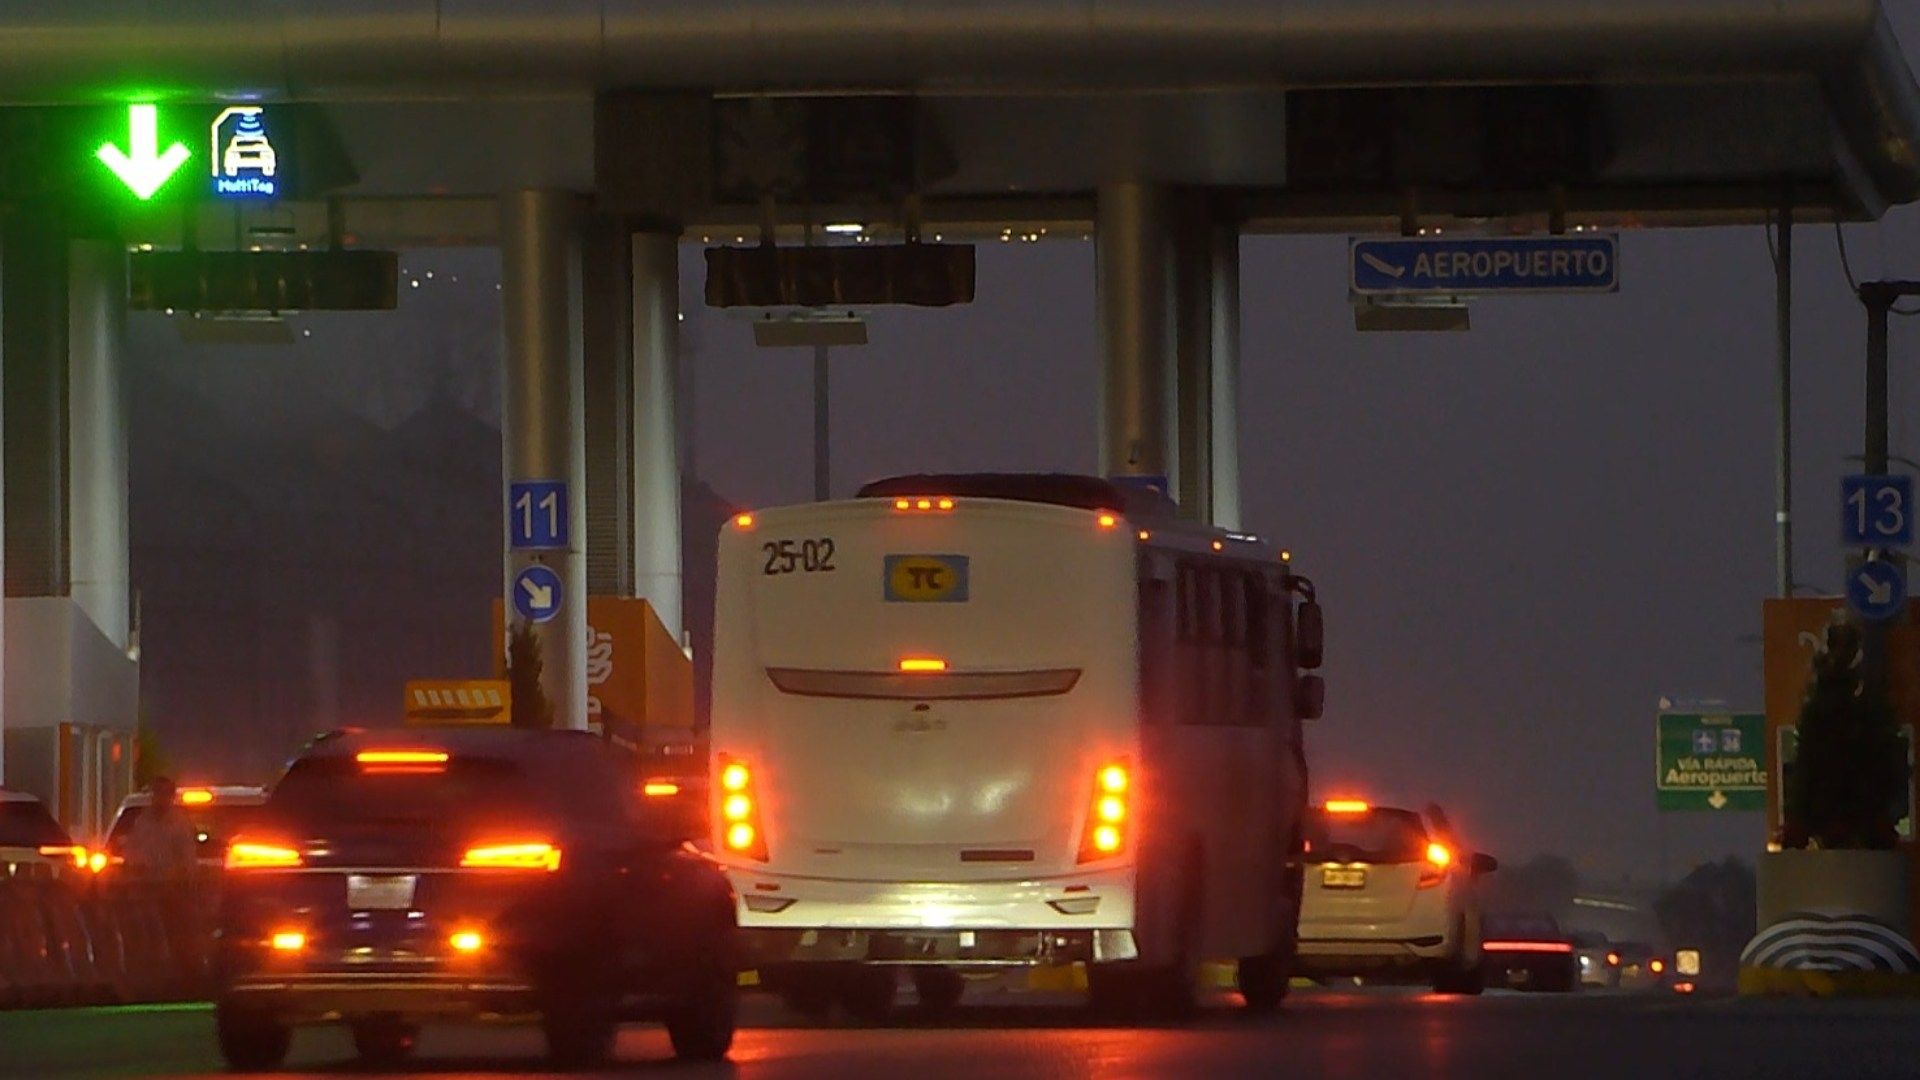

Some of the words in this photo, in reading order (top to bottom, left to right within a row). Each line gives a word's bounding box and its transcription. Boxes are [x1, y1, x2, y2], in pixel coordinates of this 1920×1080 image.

[1413, 249, 1608, 278] AEROPUERTO
[515, 490, 558, 539] 11
[1848, 485, 1904, 536] 13
[762, 538, 836, 576] 25-02
